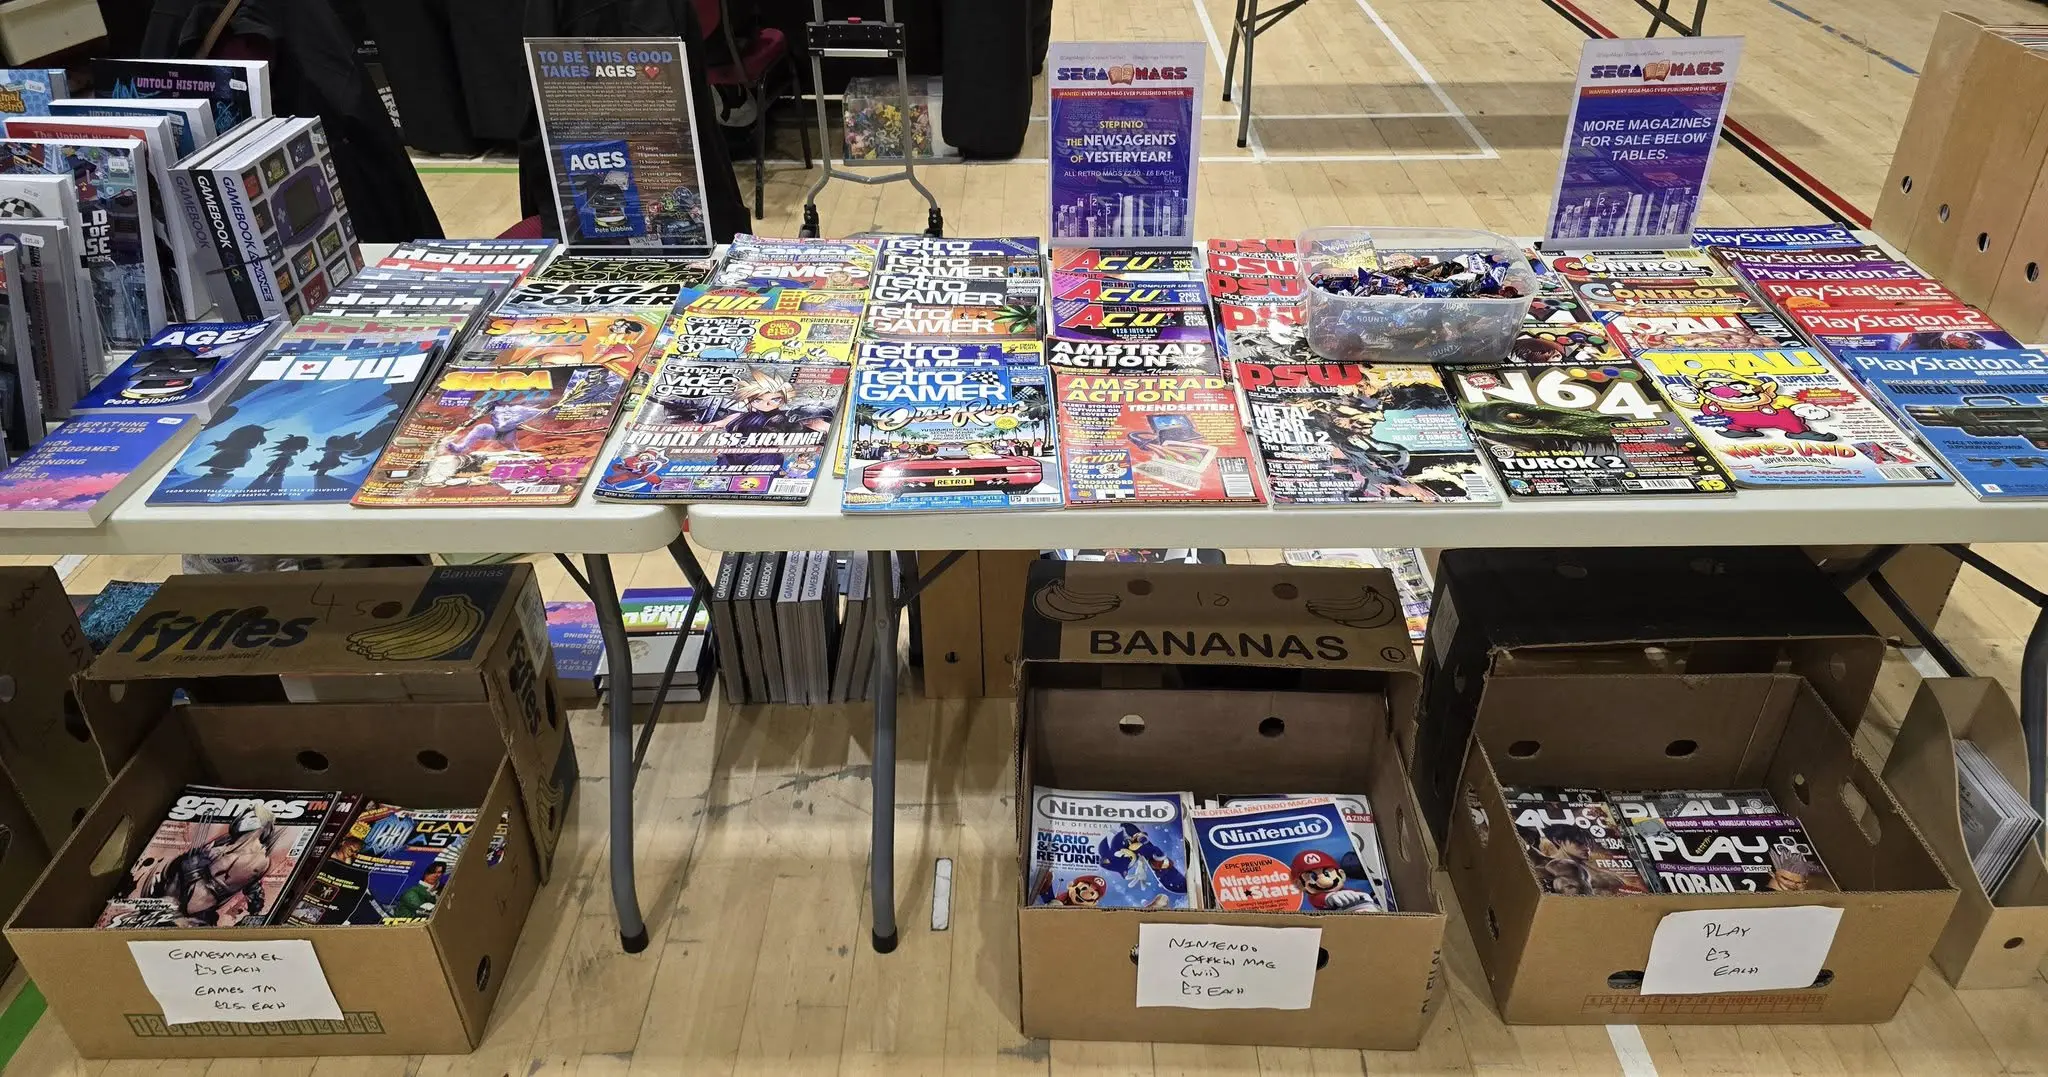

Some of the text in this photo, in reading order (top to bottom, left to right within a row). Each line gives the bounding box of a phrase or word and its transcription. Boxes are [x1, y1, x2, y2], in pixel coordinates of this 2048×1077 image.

[538, 51, 673, 64] TO BE THIS GOOD
[541, 65, 637, 78] TAKES AGES
[1057, 66, 1188, 81] SEGA MAGS
[1590, 62, 1725, 79] SEGA MAGS
[137, 77, 216, 92] UNTOLD HISTORY
[1099, 121, 1144, 129] STEP INTO
[1583, 118, 1712, 132] MORE MAGAZINES
[1066, 134, 1176, 146] THE NEWSAGENTS
[1581, 133, 1707, 147] FOR SALE BELOW
[570, 151, 627, 171] AGES
[1070, 152, 1171, 163] OF YESTERYEAR!
[1612, 149, 1669, 161] TABLES.
[175, 175, 211, 250] GAMEBOOK
[197, 174, 233, 250] GAMEBOOK
[222, 176, 257, 250] GAMEBOOK
[886, 237, 973, 251] retro
[1693, 230, 1847, 246] PlayStation 2
[889, 255, 971, 268] retro
[1058, 250, 1160, 273] ACU
[1724, 248, 1887, 264] PlayStation 2
[885, 266, 1004, 279] GAMER
[1553, 256, 1701, 277] CONTROL
[1750, 266, 1921, 281] PlayStation 2
[526, 283, 682, 295] SEGA
[879, 274, 968, 293] retro
[1055, 279, 1164, 302] ACU
[875, 289, 1003, 306] GAMER
[1580, 282, 1735, 302] CONTROL
[1768, 283, 1949, 300] PlayStation 2
[512, 294, 679, 306] POWER
[868, 302, 950, 320] retro
[1058, 304, 1166, 329] ACU
[485, 318, 590, 336] SEGA
[687, 316, 760, 326] computer
[769, 322, 791, 330] ONLY
[868, 319, 994, 334] GAMER
[1801, 310, 1989, 333] PlayStation 2
[151, 321, 270, 346] AGES
[861, 342, 959, 360] retro
[1050, 341, 1206, 356] AMSTRAD
[1049, 355, 1168, 367] ACTION
[1641, 351, 1830, 376] TOTAL!
[1855, 354, 2048, 376] PlayStation 2
[665, 364, 746, 375] computer
[862, 366, 966, 385] retro
[440, 369, 554, 391] SEGA
[1067, 377, 1225, 390] AMSTRAD
[1777, 374, 1839, 383] SUPER NES
[859, 384, 1007, 402] GAMER
[1066, 390, 1186, 402] ACTION
[1459, 366, 1663, 421] N64
[1887, 384, 1956, 395] UNREAL
[104, 394, 187, 406] Pete Gibbins
[1128, 404, 1235, 412] TRENDSETTER!
[1252, 403, 1315, 420] METAL
[67, 421, 149, 429] EVERYTHING
[1255, 417, 1308, 433] GEAR
[628, 432, 706, 447] TOTALLY
[1259, 430, 1332, 445] SOLID 2
[1071, 452, 1126, 464] ACTION
[1796, 442, 1857, 460] LAND
[18, 458, 87, 466] CHANGING
[1497, 456, 1627, 470] TUROK 2
[3, 472, 50, 480] WORLD
[490, 464, 586, 481] BEAST
[1697, 477, 1727, 491] 19
[440, 568, 504, 580] Bananas
[716, 563, 733, 599] GAMEBOOK
[738, 562, 755, 598] GAMEBOOK
[758, 561, 774, 597] GAMEBOOK
[783, 563, 797, 600] GAMEBOOK
[807, 562, 821, 599] GAMEBOOK
[1089, 630, 1349, 661] BANANAS
[168, 795, 329, 821] games TM
[1050, 800, 1165, 819] Nintendo
[1207, 797, 1330, 816] OFFICIAL NINTENDO MAGAZINE
[1037, 832, 1089, 844] MARIO
[1219, 820, 1321, 844] Nintendo
[1050, 843, 1095, 855] SONIC
[1036, 850, 1100, 864] RETURN!
[1241, 859, 1273, 869] PREVIEW
[1596, 859, 1618, 868] FIFA
[1219, 871, 1290, 887] Nintendo
[1703, 922, 1751, 938] PLAY
[1169, 938, 1258, 953] NINTENDO
[221, 965, 262, 975] EACH
[1242, 958, 1277, 969] MAG
[252, 985, 277, 994] TM
[251, 1002, 286, 1011] EACH
